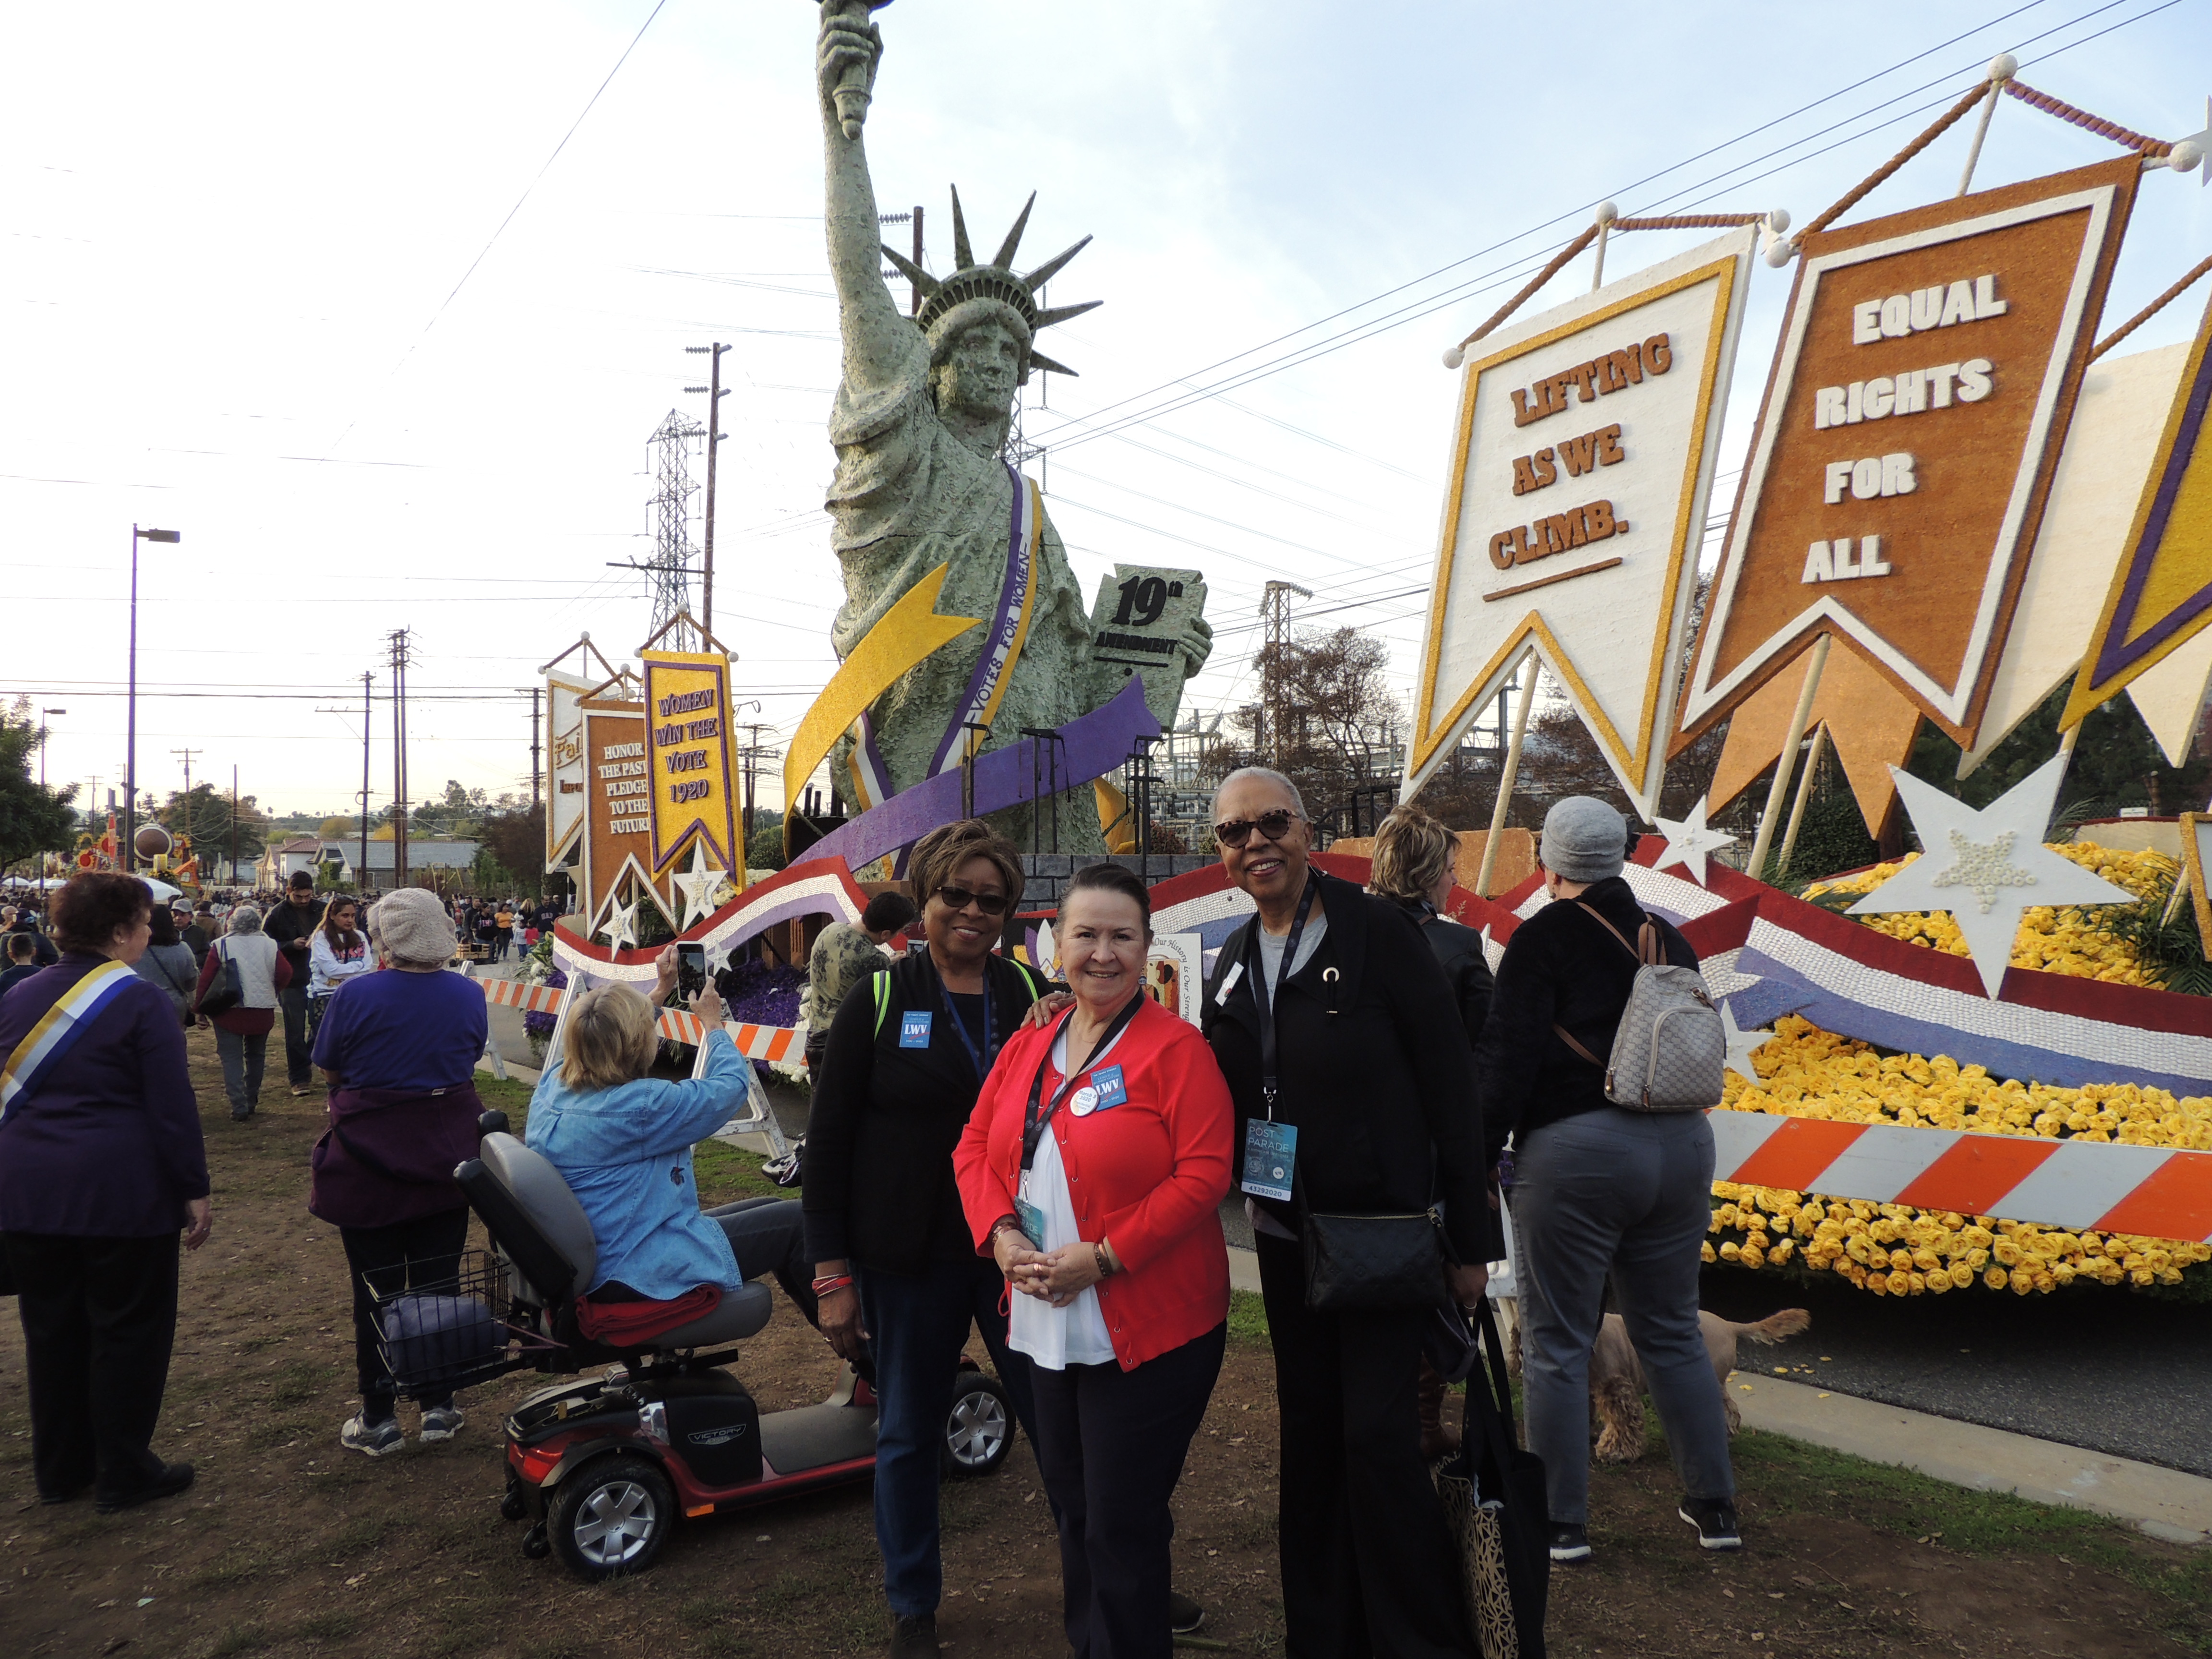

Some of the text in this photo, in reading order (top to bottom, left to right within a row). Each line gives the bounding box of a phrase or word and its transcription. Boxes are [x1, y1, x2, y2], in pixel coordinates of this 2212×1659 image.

[1853, 274, 2008, 345] EQUAL
[1511, 332, 1673, 428] LIFTING
[1815, 358, 1994, 430] RIGHTS
[1512, 423, 1625, 496] AS WE
[1825, 452, 1918, 505] FOR
[1489, 499, 1629, 570] CLIMB.
[1801, 534, 1892, 584] ALL
[971, 552, 1030, 711] VOTES FOR WOMEN
[1095, 632, 1178, 654] AMENDMENT
[657, 689, 713, 717] WOMEN
[655, 718, 718, 746] WIN THE
[555, 732, 580, 765] Fai
[604, 743, 644, 760] HONOR
[598, 760, 647, 779] THE PAST
[665, 750, 708, 773] VOTE
[606, 779, 647, 796] PLEDGE
[669, 779, 709, 803] 1920
[609, 798, 648, 815] TO THE
[1154, 938, 1166, 946] Our
[1168, 939, 1188, 963] History
[1182, 994, 1190, 1022] Streng
[904, 1024, 927, 1035] LWV
[1095, 1078, 1119, 1096] LWV
[1249, 1126, 1275, 1138] POST
[1248, 1137, 1289, 1152] PARADE
[1249, 1185, 1282, 1197] 43292020
[1020, 1218, 1039, 1235] RADE
[694, 1427, 741, 1441] VICTORY
